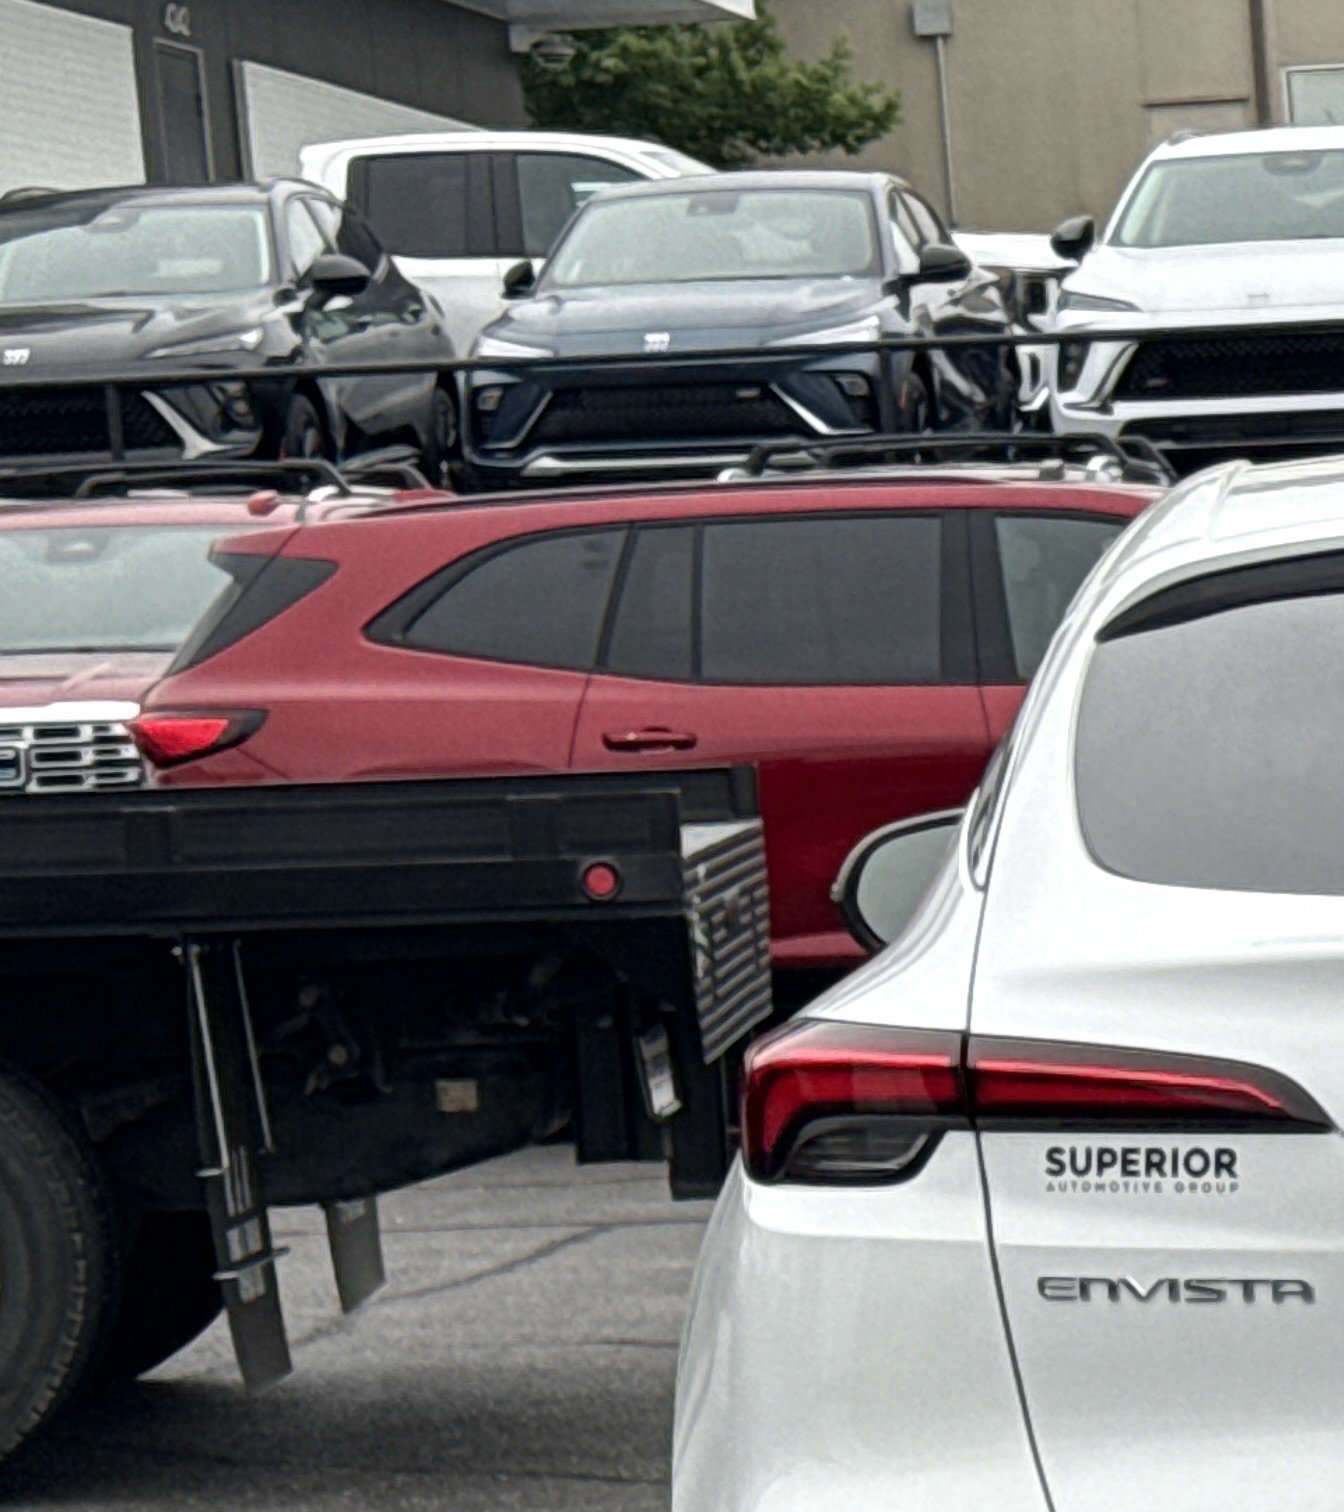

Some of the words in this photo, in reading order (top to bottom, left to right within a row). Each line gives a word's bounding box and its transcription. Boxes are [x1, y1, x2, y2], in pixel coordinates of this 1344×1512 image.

[1045, 1146, 1238, 1179] SUPERIOR
[1045, 1180, 1164, 1195] AUTOMOTIVE
[1173, 1181, 1240, 1195] GROUP
[1036, 1276, 1316, 1304] ENVISTA
